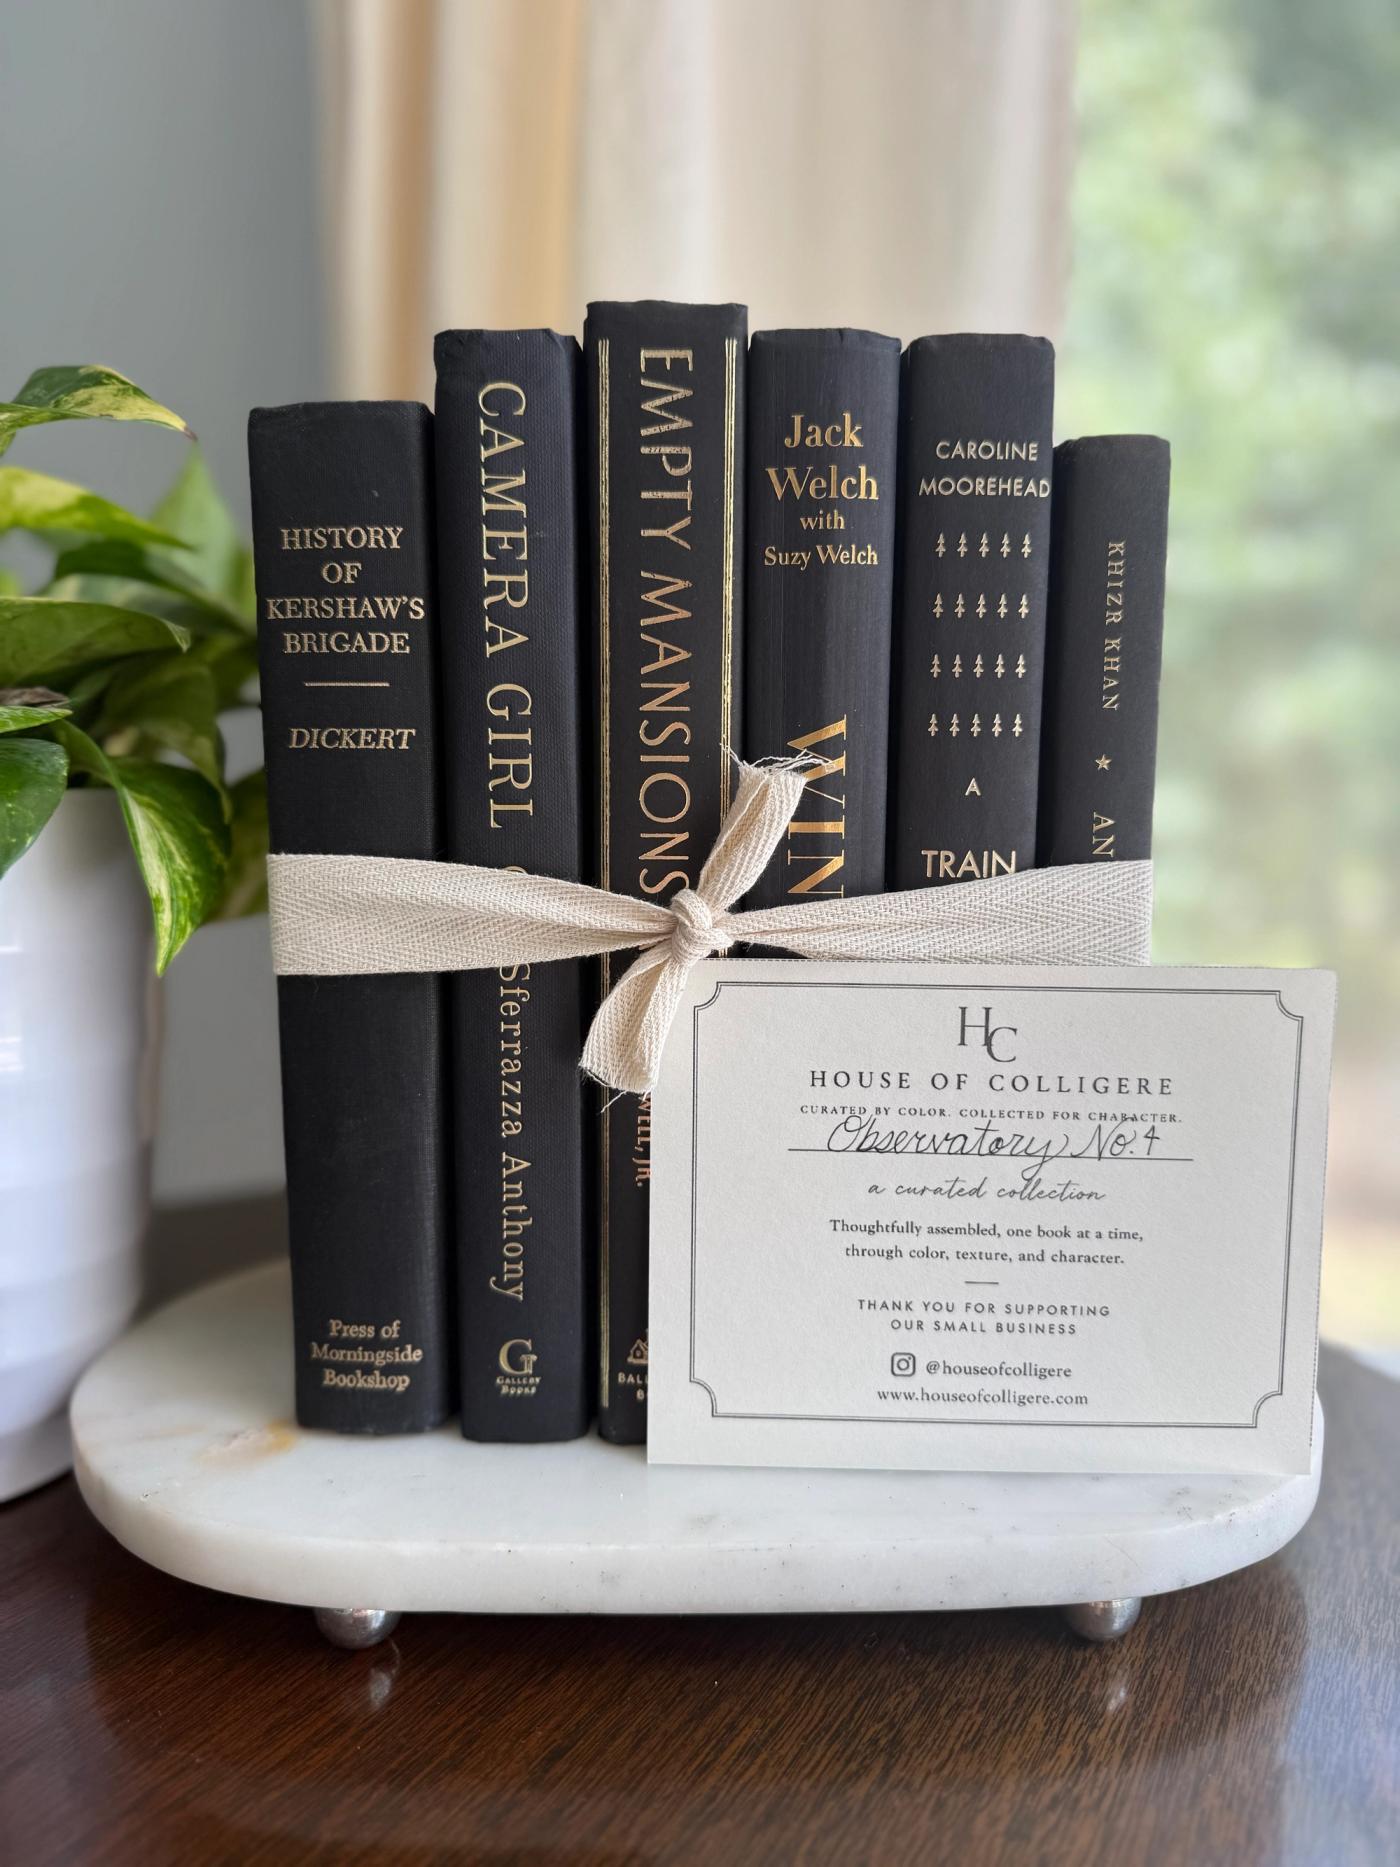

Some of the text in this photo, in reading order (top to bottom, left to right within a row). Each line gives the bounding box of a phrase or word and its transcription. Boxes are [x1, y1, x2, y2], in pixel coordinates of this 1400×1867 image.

[784, 410, 864, 449] Jack
[935, 438, 1039, 462] CAROLINE
[765, 464, 879, 501] Welch
[918, 476, 1051, 499] MOOREHEAD
[478, 381, 530, 660] CAMERA
[800, 509, 845, 531] with
[280, 526, 404, 551] HISTORY
[764, 544, 878, 571] Suzy Welch
[321, 562, 362, 585] OF
[266, 596, 426, 621] KERSHAW'S
[638, 347, 693, 894] EMPTY MANSIONS
[1102, 540, 1125, 711] KHIZR KHAN
[283, 632, 411, 655] BRIGADE
[289, 727, 417, 750] DICKERT
[486, 682, 534, 830] GIRL
[965, 777, 982, 797] A
[921, 849, 1017, 879] TRAIN
[957, 1006, 1018, 1063] HC
[809, 1070, 1173, 1096] HOUSE OF COLLIGERE
[800, 1105, 1183, 1124] CURATED BY COLOR. COLLECTED FOR CHARACTER.
[489, 962, 533, 1302] Sferrazza Anthony
[827, 1114, 1070, 1181] Observatory
[1143, 1124, 1161, 1156] 4
[867, 1176, 1107, 1202] a curated collection
[829, 1219, 1144, 1242] Thoughtfully assembled, one book at a time,
[845, 1246, 1125, 1264] through color, texture, and character.
[858, 1299, 1111, 1317] THANK YOU FOR SUPPORTING
[329, 1318, 402, 1338] Press of
[890, 1319, 1077, 1335] OUR SMALL BUSINESS
[311, 1342, 424, 1367] Morningside
[323, 1368, 411, 1393] Bookshop
[926, 1360, 1072, 1380] @houseofcolligere
[877, 1388, 1089, 1407] www.houseofcolligere.com
